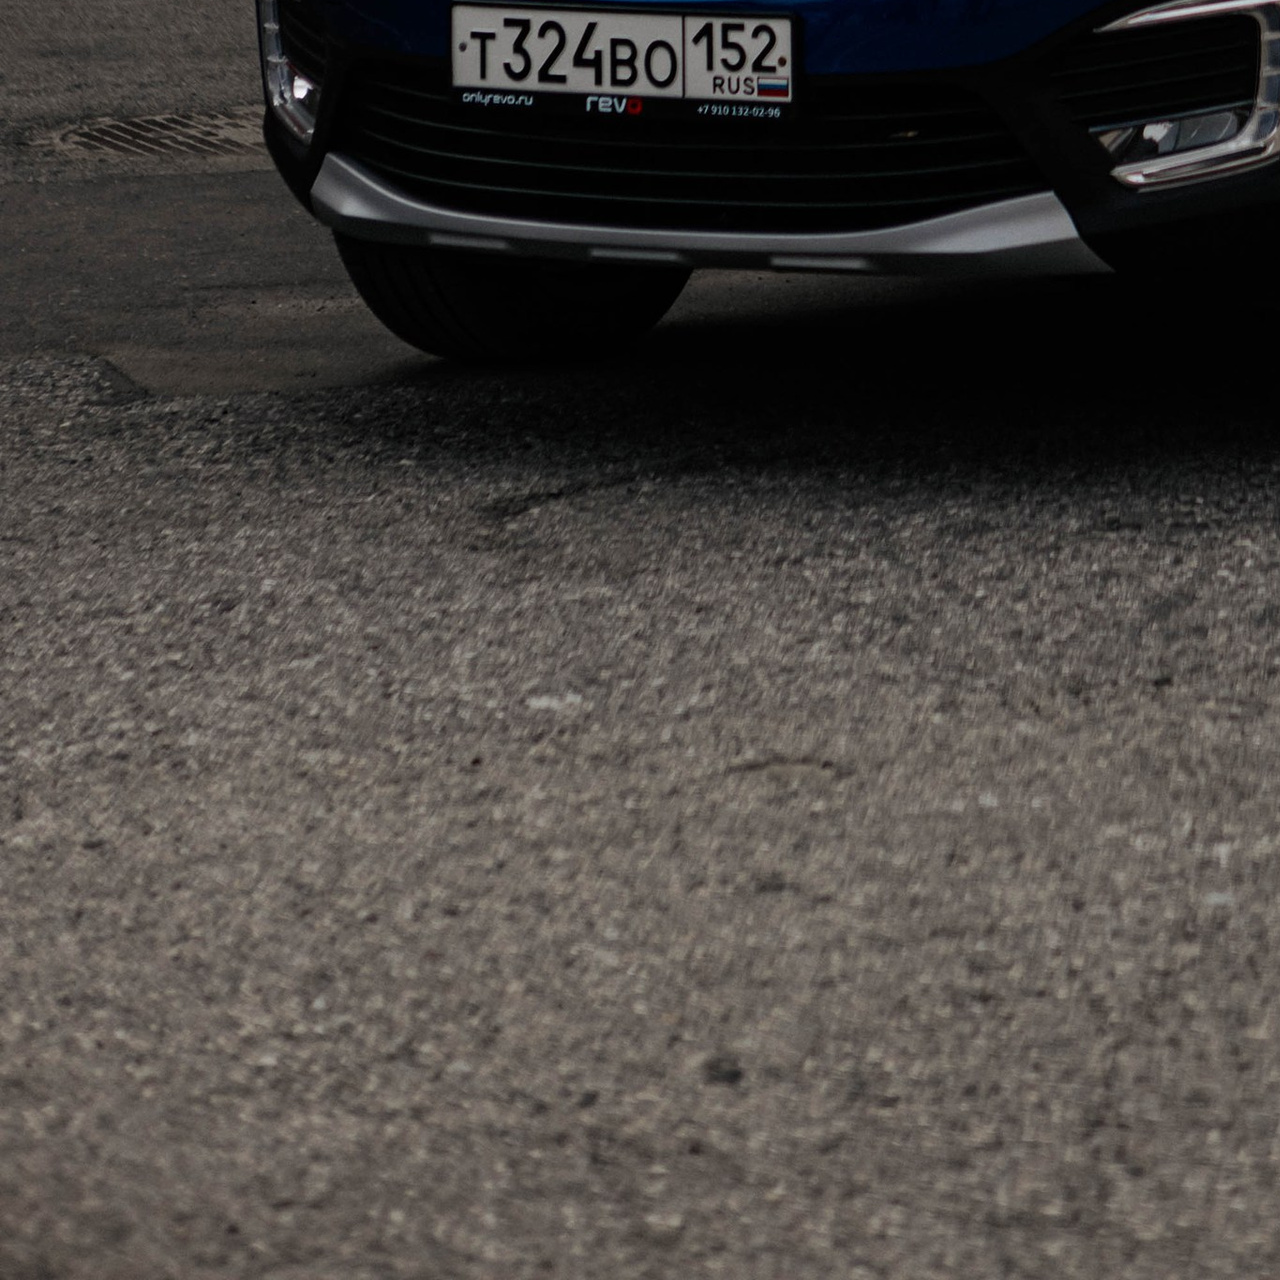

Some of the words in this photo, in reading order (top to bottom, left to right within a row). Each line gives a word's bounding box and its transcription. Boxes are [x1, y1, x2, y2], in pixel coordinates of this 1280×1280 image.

[692, 22, 777, 73] 152
[712, 75, 755, 96] RUS
[461, 89, 534, 107] onlyrevo.ru
[585, 94, 644, 117] revo
[696, 103, 710, 116] +7
[710, 104, 730, 117] 910
